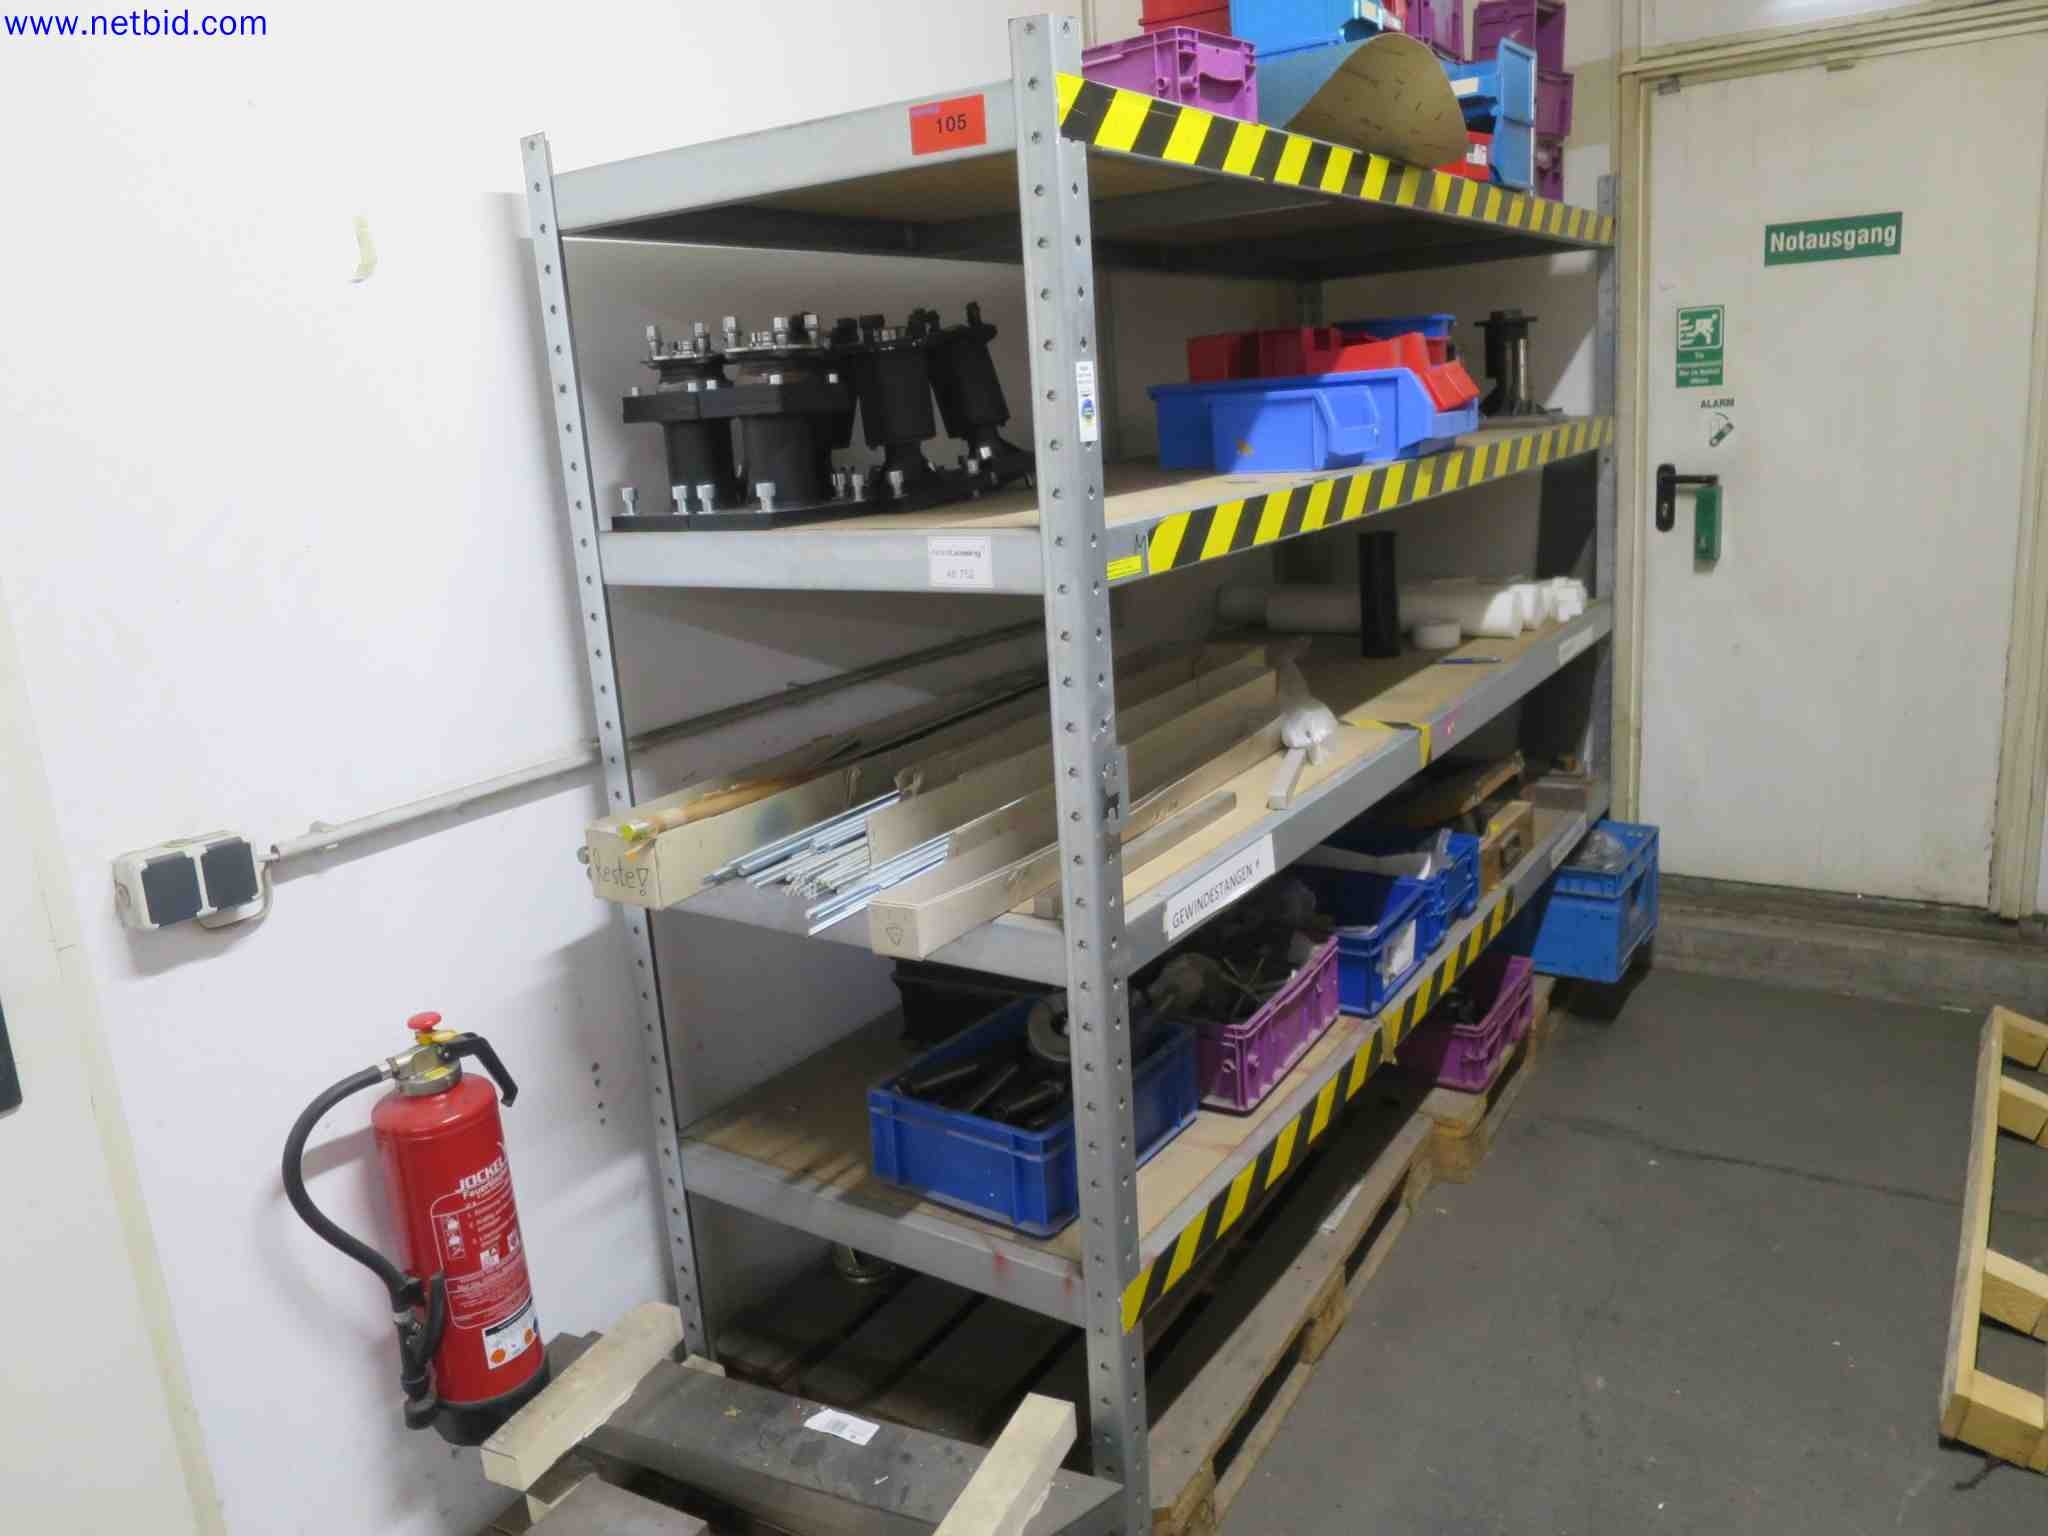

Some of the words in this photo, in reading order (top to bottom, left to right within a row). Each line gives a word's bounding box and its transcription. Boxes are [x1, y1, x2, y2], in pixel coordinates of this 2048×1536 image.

[936, 113, 967, 134] 105
[1770, 224, 1897, 251] Notausgang
[1700, 398, 1735, 409] ALARM
[1172, 863, 1253, 929] GEWINDESTANGEN
